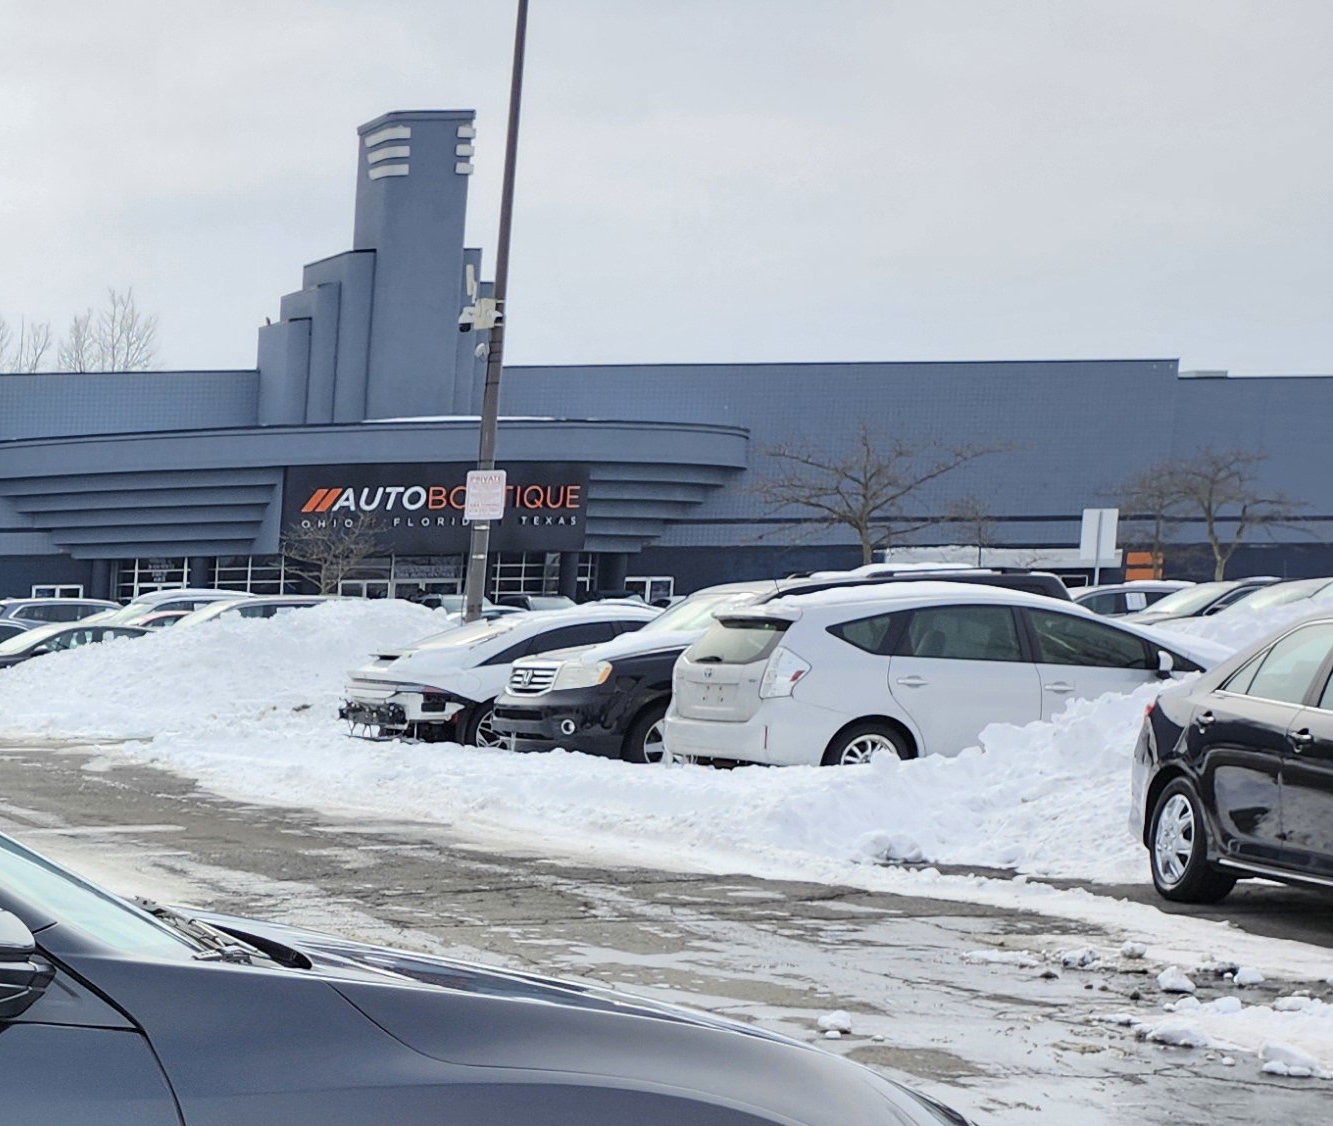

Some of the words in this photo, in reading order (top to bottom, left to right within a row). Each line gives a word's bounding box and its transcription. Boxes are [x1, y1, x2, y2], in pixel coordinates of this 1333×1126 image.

[332, 485, 581, 512] AUTOBOIQUE
[301, 519, 353, 528] OHIO
[393, 517, 470, 527] FLORID
[521, 516, 577, 526] TEXAS
